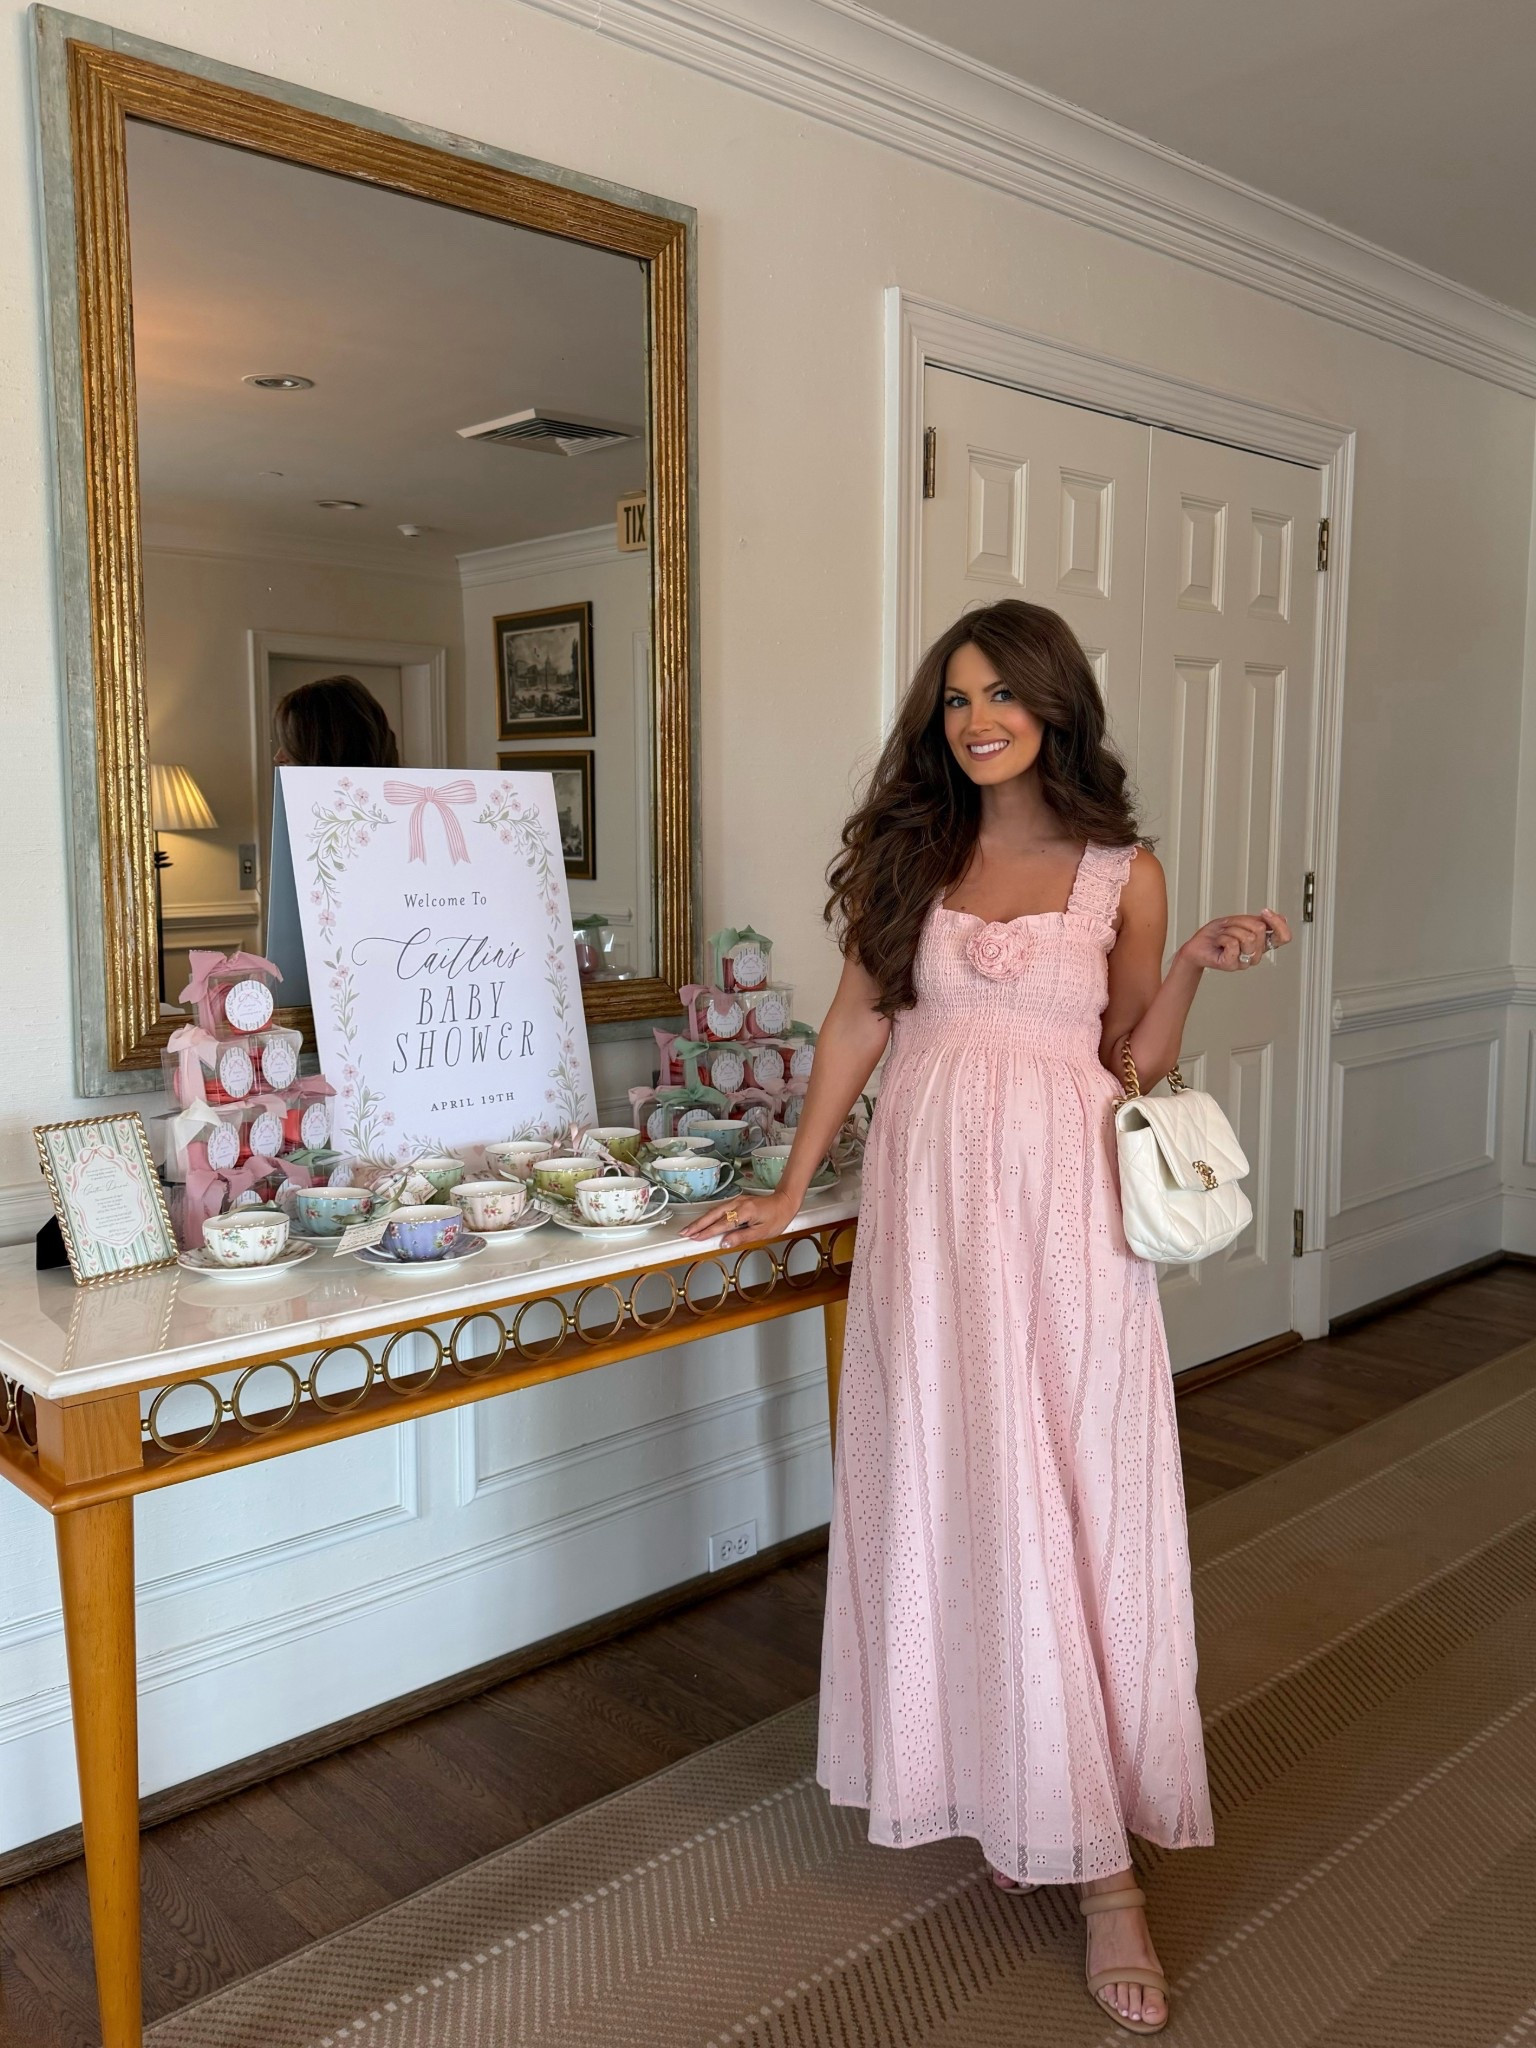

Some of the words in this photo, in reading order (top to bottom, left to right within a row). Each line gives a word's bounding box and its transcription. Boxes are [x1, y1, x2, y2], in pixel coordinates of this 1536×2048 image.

[404, 892, 466, 908] Welcome
[472, 891, 487, 906] To
[351, 928, 526, 980] Caitlin's
[416, 981, 506, 1026] BABY
[392, 1020, 535, 1074] SHOWER
[430, 1098, 475, 1113] APRIL
[481, 1091, 515, 1105] 19TH
